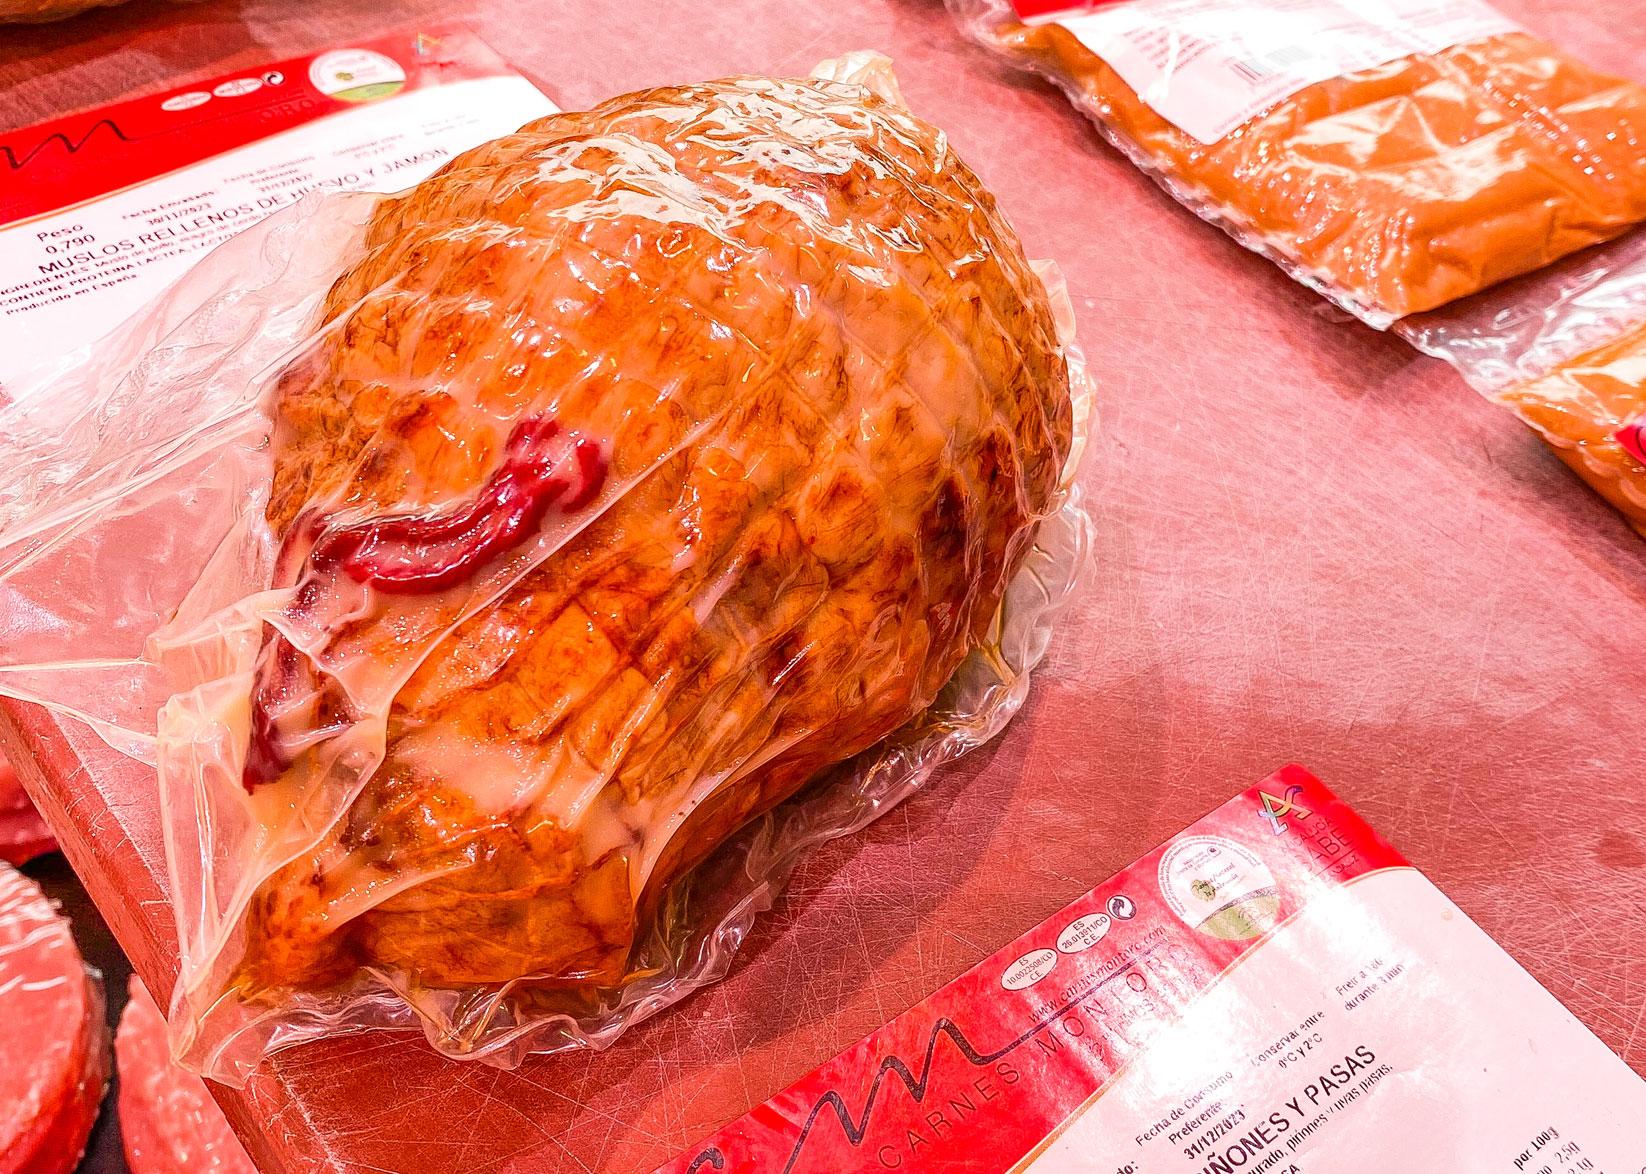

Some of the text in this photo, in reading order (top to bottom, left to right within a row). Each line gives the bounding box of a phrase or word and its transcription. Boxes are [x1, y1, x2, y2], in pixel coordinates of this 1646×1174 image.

[37, 224, 84, 242] Peso
[38, 239, 136, 275] MUSLOS
[138, 204, 254, 245] RELLENOS
[256, 193, 289, 210] DE
[45, 233, 96, 254] 0,790
[1072, 920, 1085, 931] ES
[1018, 956, 1029, 967] ES
[1251, 1010, 1326, 1068] Conservar entre
[1296, 1046, 1307, 1058] y
[1285, 1096, 1305, 1118] Y
[1303, 1045, 1377, 1107] PASAS
[1358, 1063, 1394, 1095] pasas.
[877, 1060, 1021, 1170] CARNES
[1135, 1070, 1234, 1147] Fecha de Consumo
[1183, 1108, 1247, 1160] 31/12/2023
[1513, 1126, 1560, 1172] por 100g
